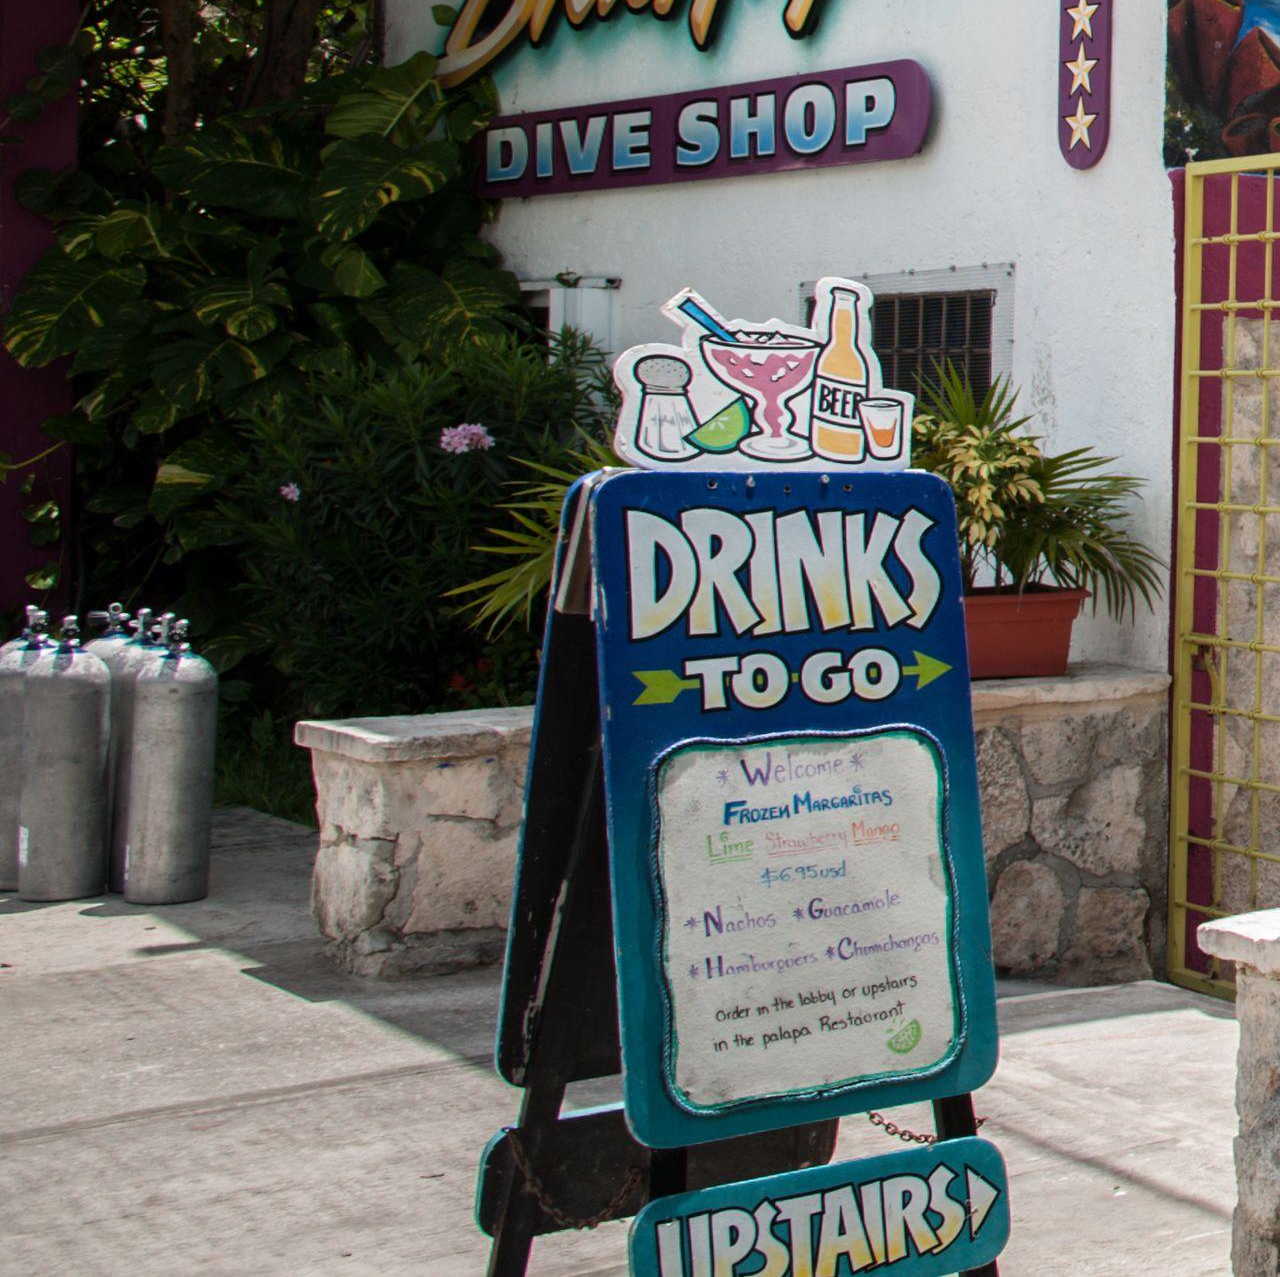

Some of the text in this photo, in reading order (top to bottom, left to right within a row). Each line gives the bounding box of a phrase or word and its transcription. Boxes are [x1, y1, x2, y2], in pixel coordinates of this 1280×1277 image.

[485, 76, 897, 183] DIVE SHOP
[818, 383, 864, 420] BEER
[625, 506, 943, 642] DRINKS
[684, 647, 901, 710] TO GO
[740, 751, 844, 787] Welcome
[706, 831, 755, 858] Lime
[703, 889, 902, 938] Nachos Guacamole
[715, 1004, 751, 1023] Order
[772, 996, 796, 1012] the
[798, 989, 836, 1006] lobby
[842, 986, 858, 999] or
[862, 974, 918, 1000] upstairs
[713, 1037, 728, 1053] in
[733, 1031, 755, 1048] the
[762, 1024, 812, 1050] palapa
[655, 1163, 968, 1277] UPSTAIRS
